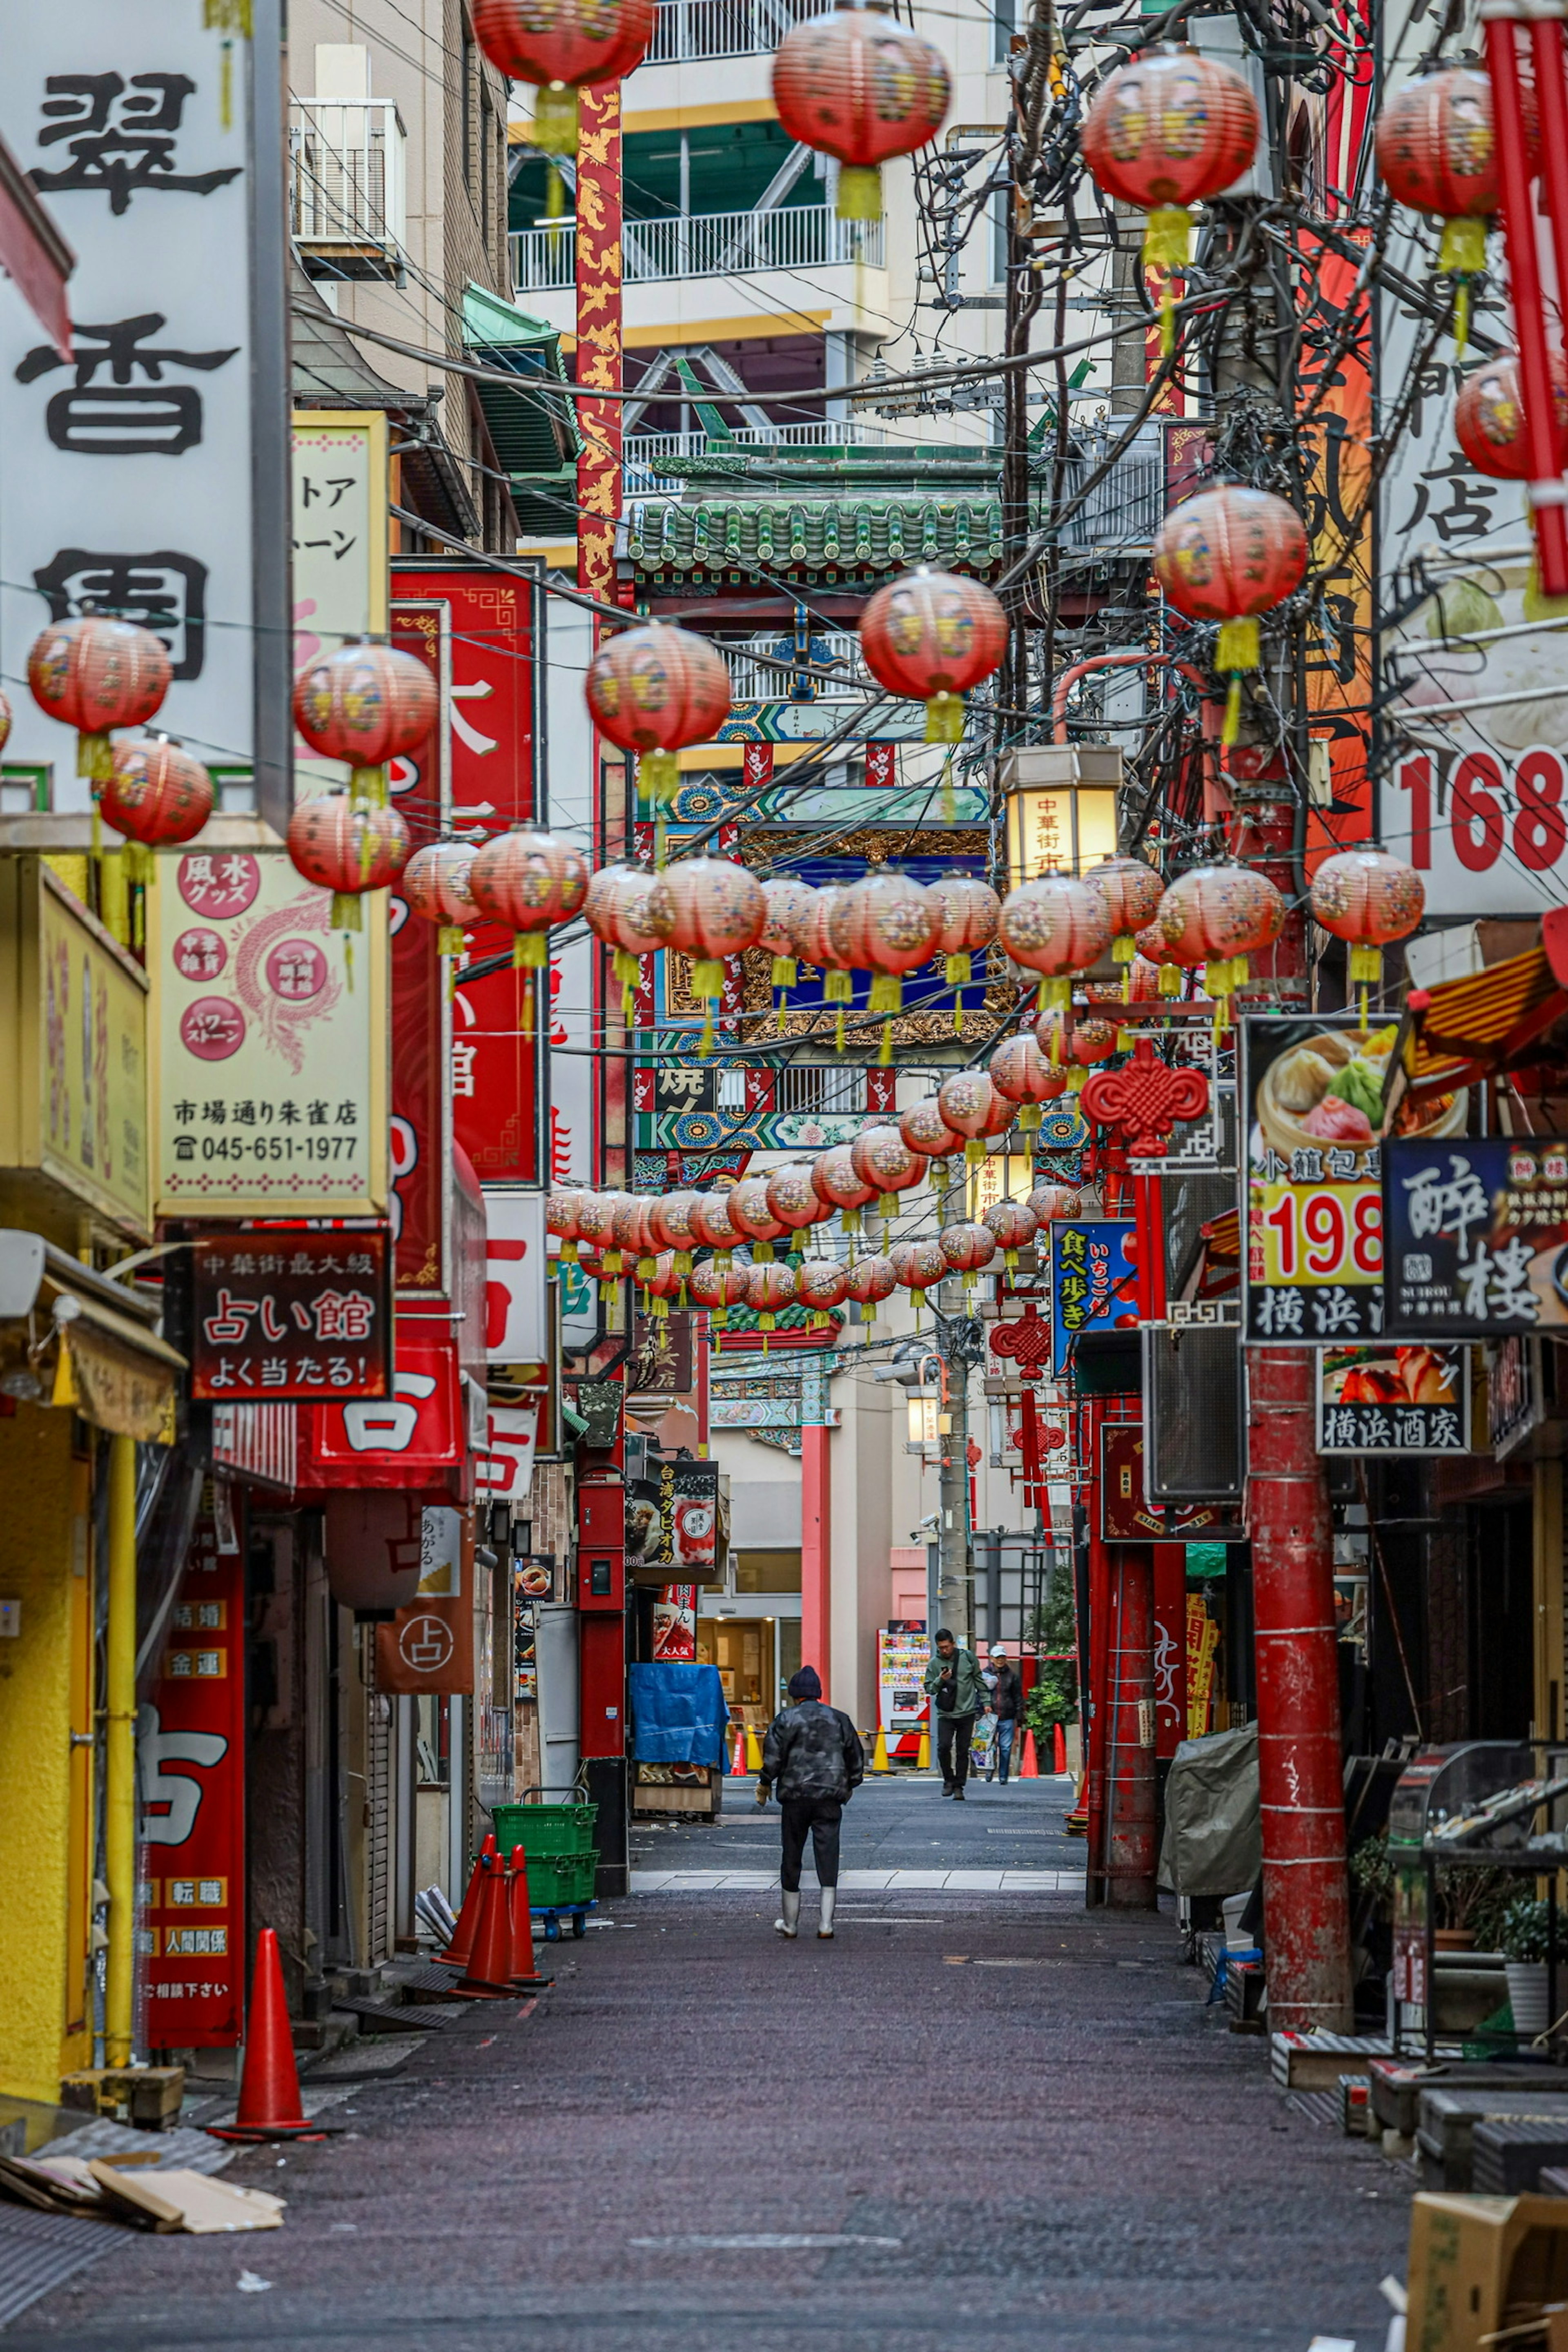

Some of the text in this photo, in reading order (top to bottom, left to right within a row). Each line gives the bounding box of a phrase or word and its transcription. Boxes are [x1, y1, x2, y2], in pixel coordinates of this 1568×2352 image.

[1401, 751, 1567, 871] 168
[184, 855, 253, 884] 風水
[188, 883, 248, 904] グッズ
[186, 1013, 239, 1031] パワー
[187, 1028, 238, 1042] ストーン
[174, 1099, 357, 1126] 市場通り朱雀店
[203, 1136, 356, 1160] 045-651-1977
[203, 1252, 375, 1276] 中華街最大級
[1060, 1229, 1087, 1329] 食べ歩き
[203, 1287, 377, 1344] 占い館
[209, 1356, 367, 1387] よく当たる!
[1324, 1407, 1461, 1447] 横浜酒家
[659, 1464, 675, 1564] 台湾タピオカ
[678, 1584, 690, 1623] 肉まん
[412, 1619, 442, 1662] 占
[662, 1646, 689, 1656] 大人気
[172, 1652, 219, 1676] 金運
[173, 1881, 221, 1904] 転職
[166, 1930, 226, 1954] 人間関係
